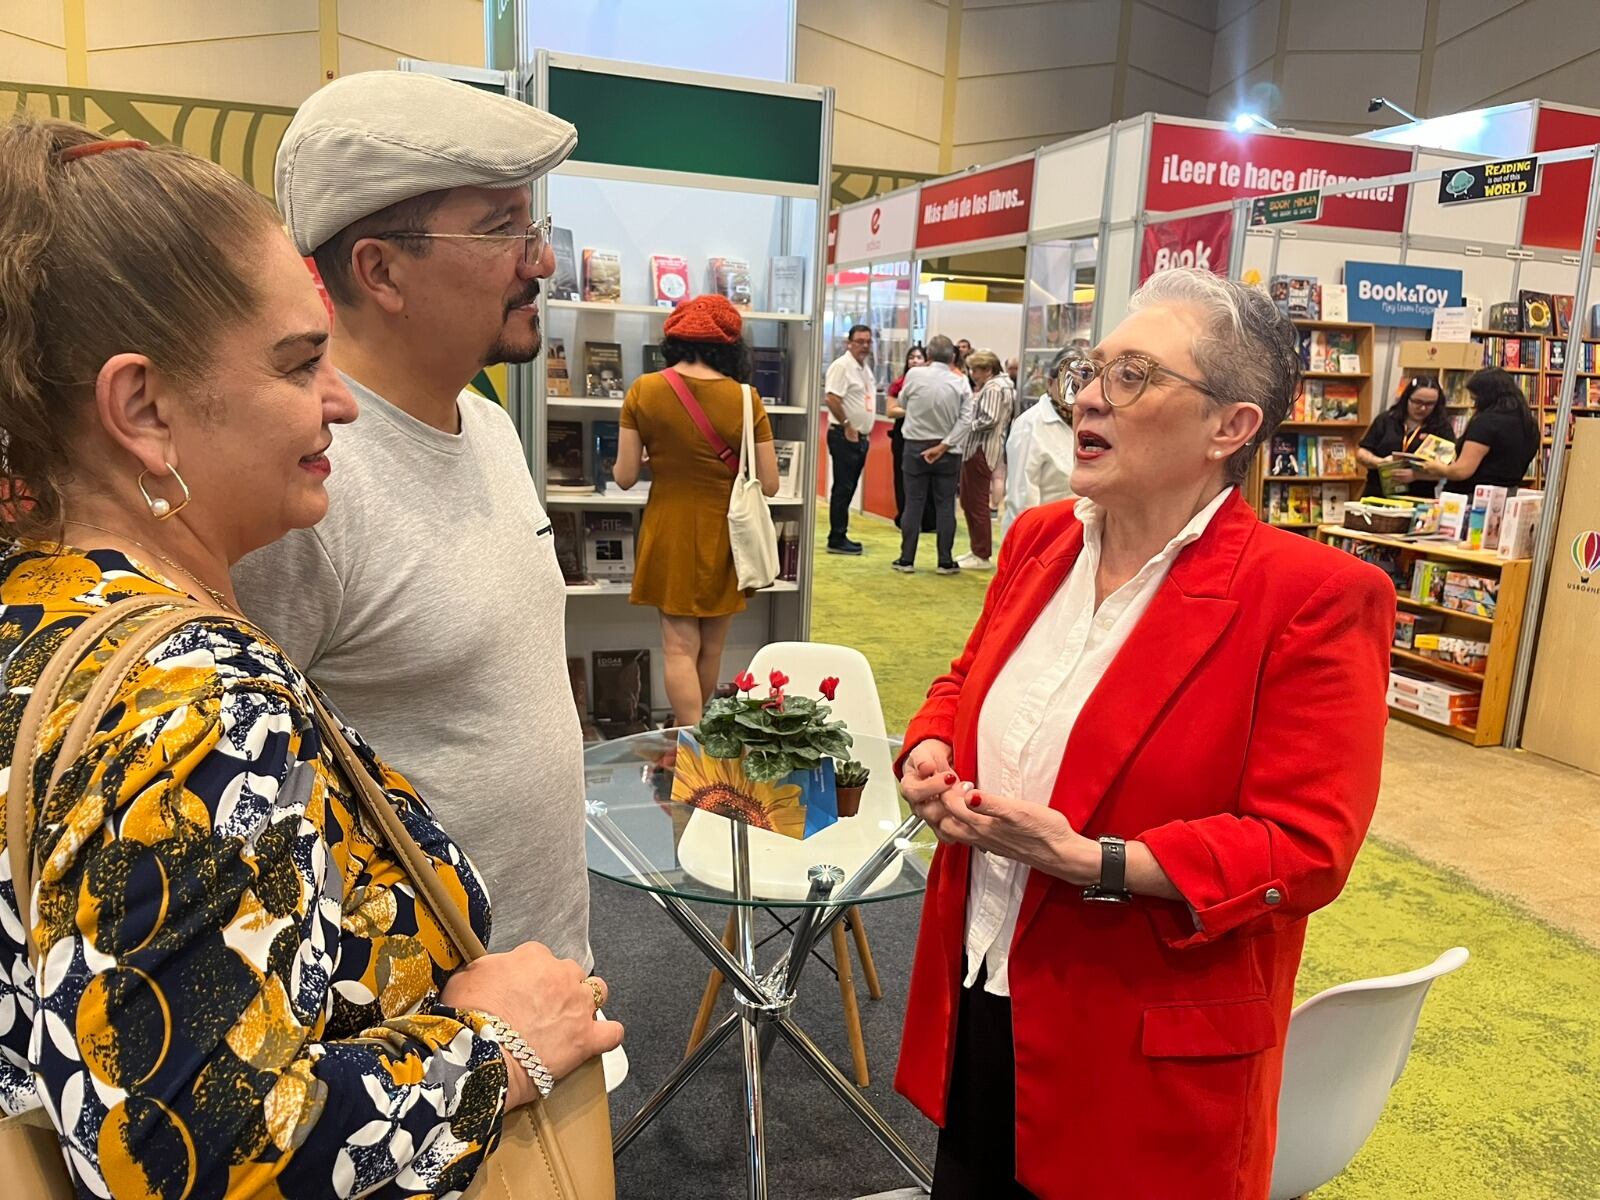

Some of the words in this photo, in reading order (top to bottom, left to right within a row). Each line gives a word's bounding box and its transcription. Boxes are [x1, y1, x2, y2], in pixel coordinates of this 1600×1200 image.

[1162, 154, 1217, 184] ¡Leer
[1219, 161, 1241, 186] te
[1244, 162, 1295, 191] hace
[1485, 160, 1531, 176] READING
[1484, 181, 1527, 197] WORLD
[924, 204, 941, 224] Más
[959, 196, 971, 218] de
[972, 194, 987, 215] los
[1154, 240, 1211, 272] Book
[1359, 280, 1448, 308] Book&Toy
